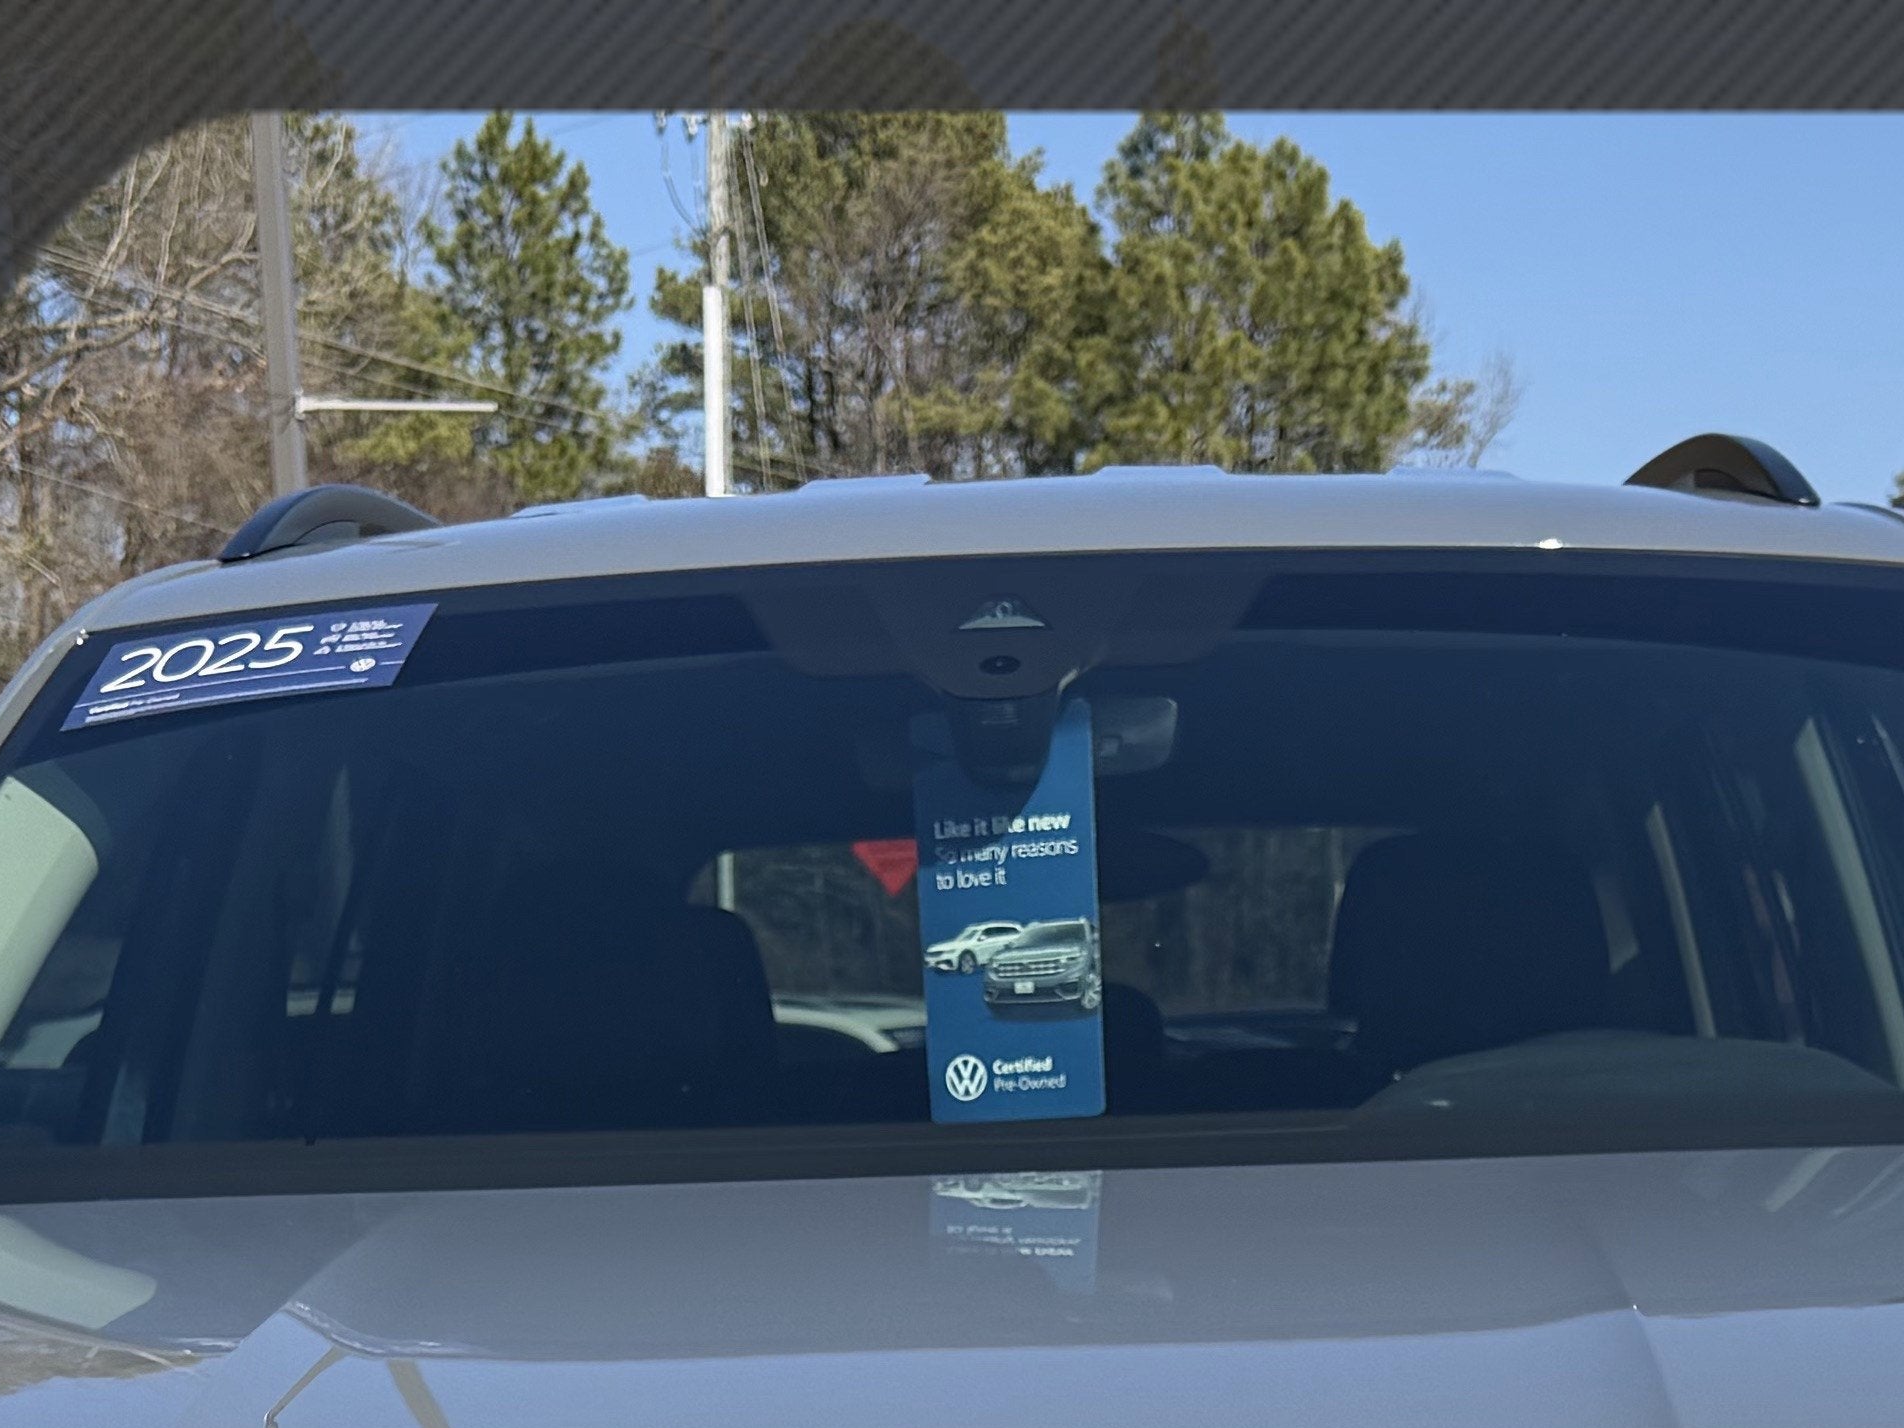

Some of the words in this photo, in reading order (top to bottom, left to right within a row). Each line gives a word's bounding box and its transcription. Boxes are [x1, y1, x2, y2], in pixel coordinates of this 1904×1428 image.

[99, 624, 315, 693] 2025
[933, 820, 971, 839] Like
[973, 818, 988, 836] it
[1028, 813, 1071, 832] new
[960, 844, 1009, 866] many
[1011, 839, 1079, 859] reasons
[936, 873, 954, 891] to
[956, 869, 992, 889] love
[994, 867, 1008, 886] it
[992, 1056, 1053, 1075] Certified
[993, 1072, 1067, 1092] Pre-Owned
